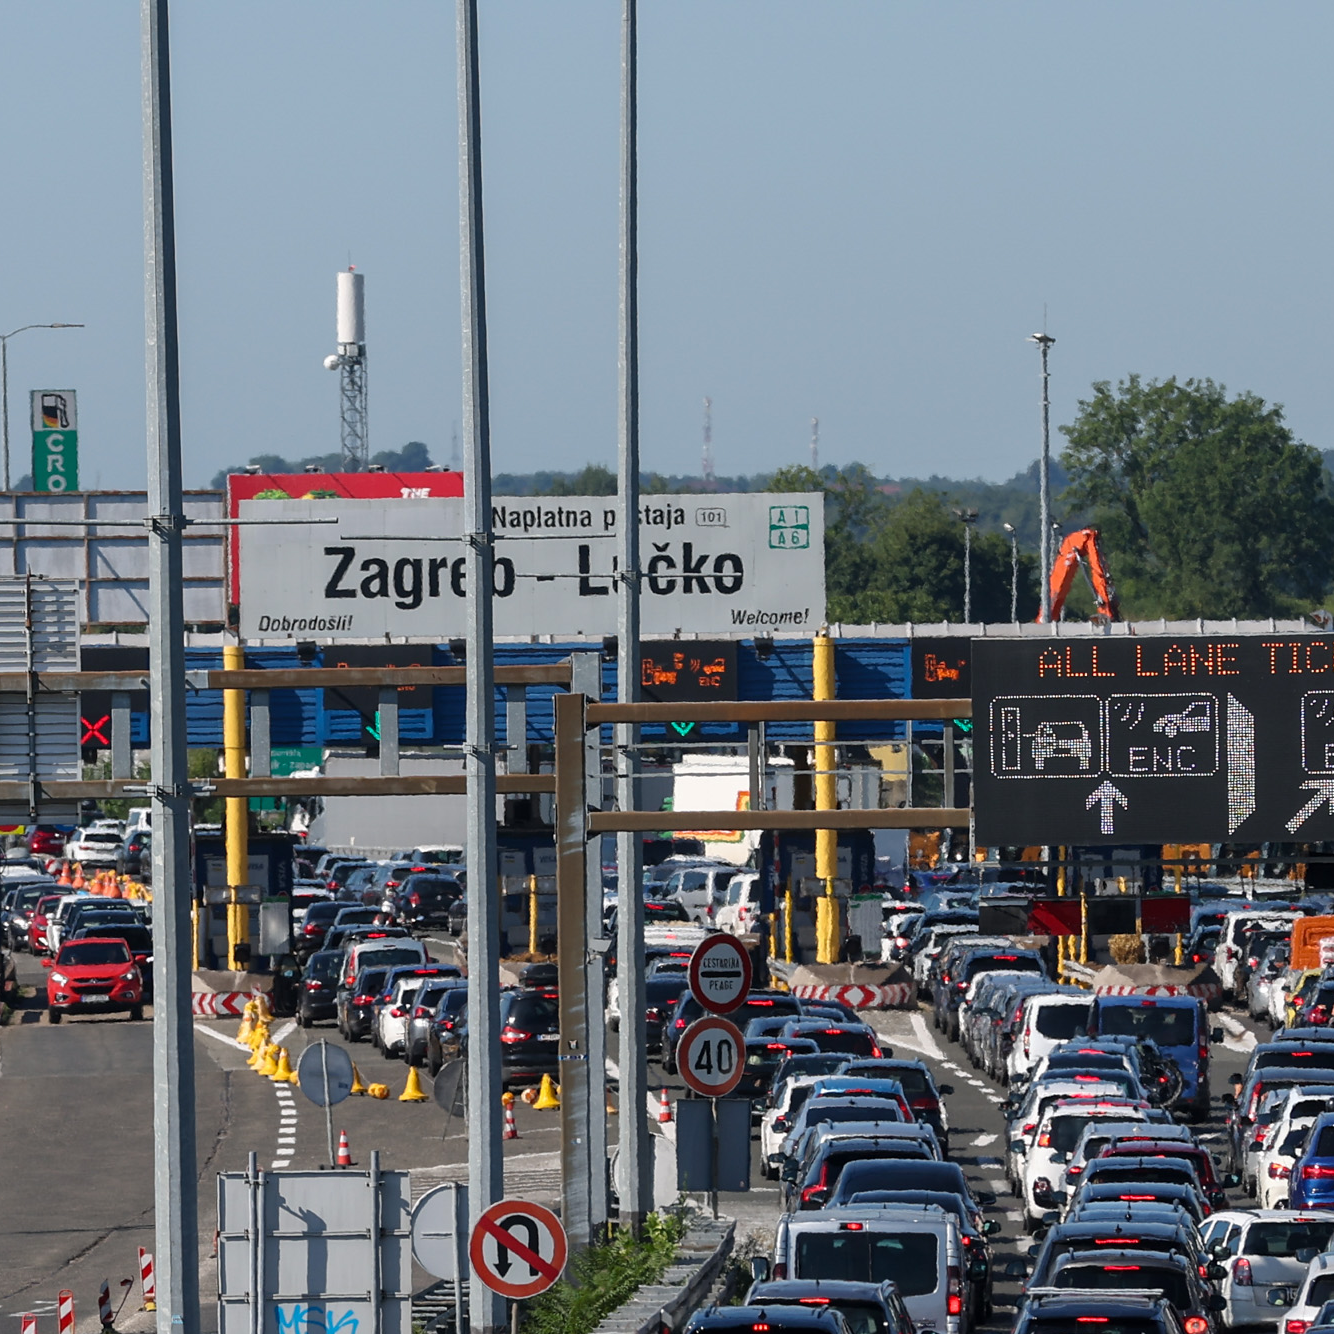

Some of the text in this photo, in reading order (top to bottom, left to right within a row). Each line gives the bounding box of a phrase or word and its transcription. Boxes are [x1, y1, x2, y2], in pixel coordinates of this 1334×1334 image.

[492, 503, 685, 532] Naplatna ptaja
[700, 511, 721, 523] 101
[777, 510, 799, 523] A1
[777, 530, 799, 545] A6
[324, 545, 516, 610] Zagreb
[578, 541, 744, 596] Lčko
[258, 614, 353, 632] Dobrodošli!
[730, 608, 810, 625] Welcome!
[1039, 645, 1115, 676] ALL
[1136, 643, 1240, 676] LANE
[1128, 745, 1196, 771] ENC
[703, 957, 740, 968] CESTARINA
[709, 980, 733, 990] PEAGE
[695, 1039, 733, 1075] 40
